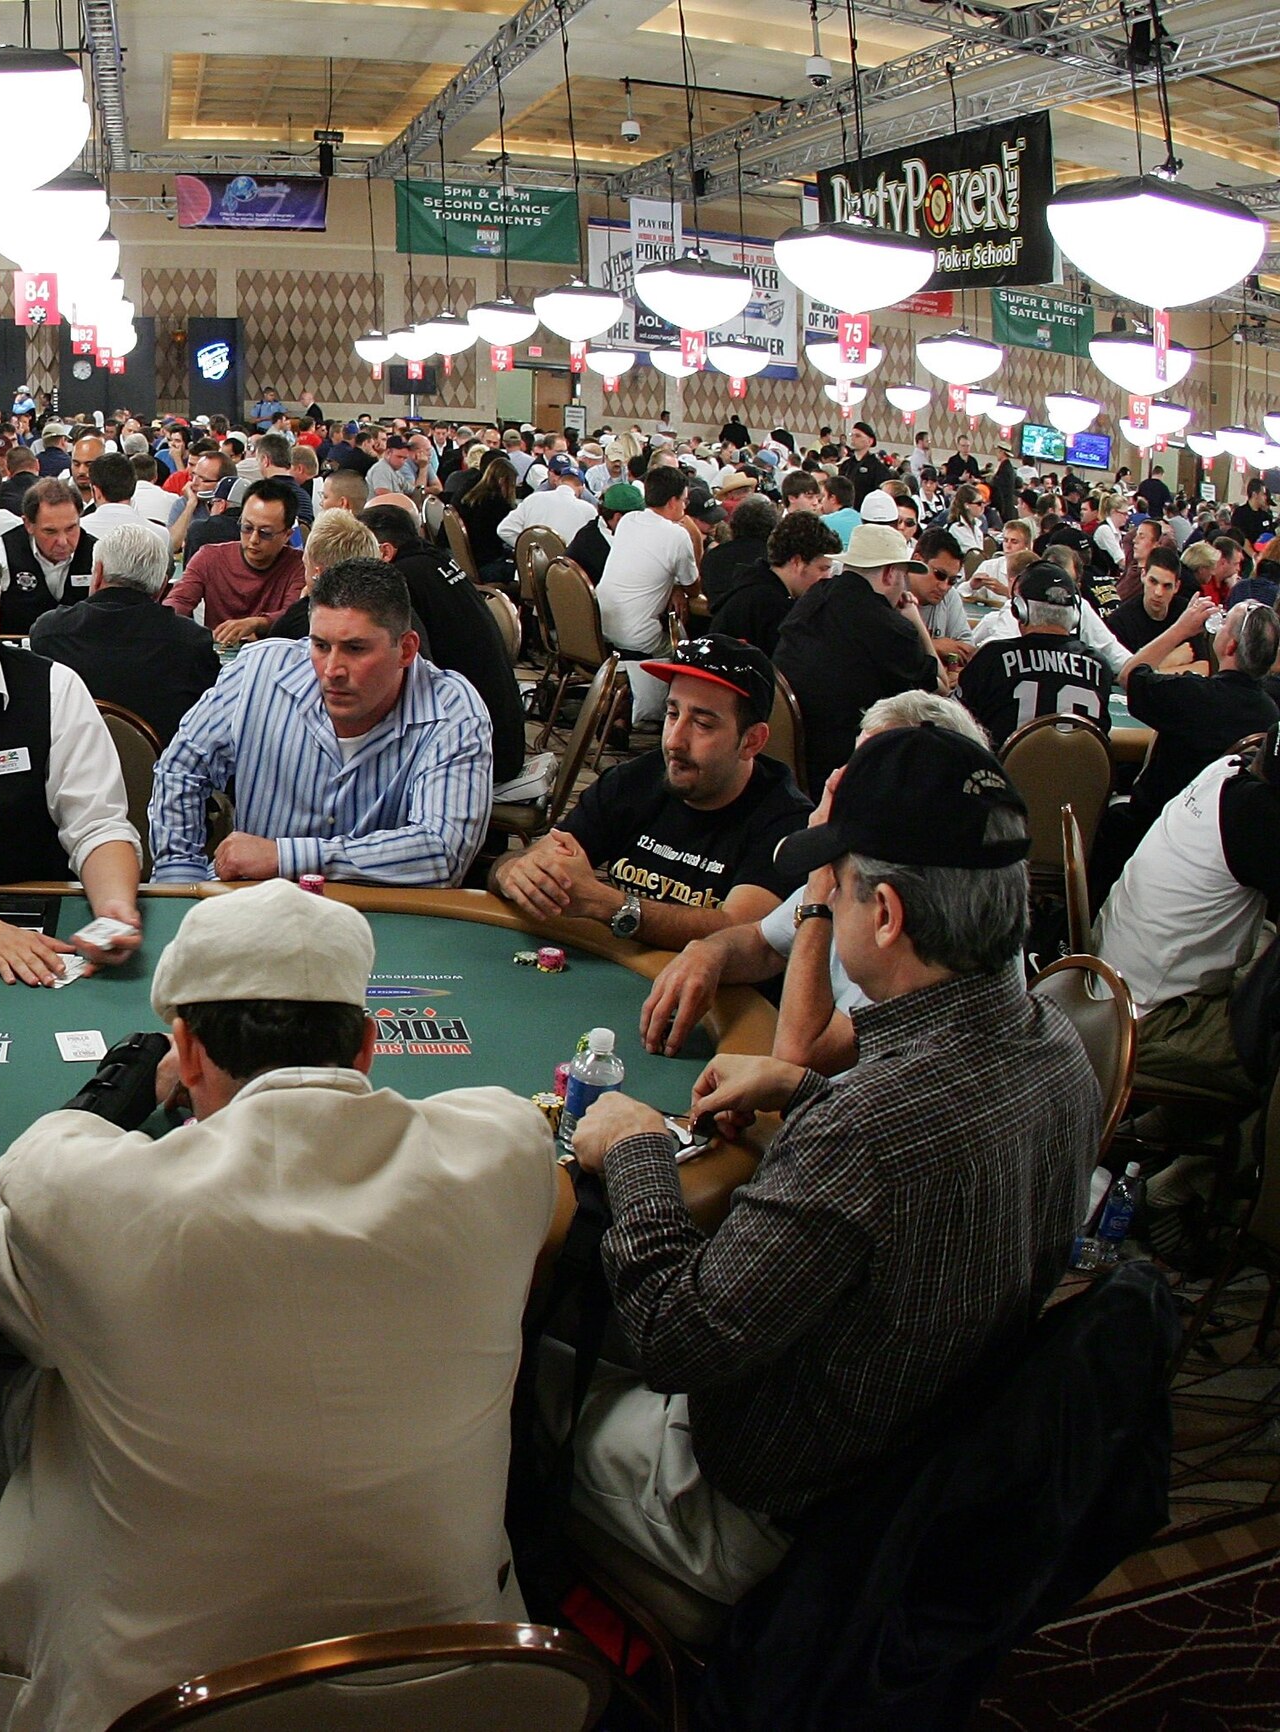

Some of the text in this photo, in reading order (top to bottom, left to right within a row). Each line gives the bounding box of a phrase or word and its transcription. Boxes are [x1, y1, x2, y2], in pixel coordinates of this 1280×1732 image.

[443, 185, 472, 198] 5PM
[478, 187, 490, 199] &
[423, 196, 551, 216] SECOND CHANCE
[432, 209, 543, 227] TOURNAMENTS
[638, 218, 656, 229] PLAY
[635, 242, 676, 262] POKER
[936, 239, 1019, 273] Poker School
[24, 280, 50, 302] 84
[810, 301, 830, 314] WORLD
[999, 290, 1086, 317] SUPER & MEGA
[638, 314, 662, 329] AOL
[808, 312, 820, 327] OF
[1009, 305, 1077, 327] SATELLITES
[79, 328, 94, 342] 82
[844, 322, 863, 344] 75
[1156, 321, 1167, 351] 76
[685, 337, 699, 353] 74
[495, 350, 508, 362] 72
[952, 388, 965, 401] 64
[1132, 401, 1147, 416] 65
[1001, 649, 1103, 687] PLUNKETT
[375, 1017, 472, 1043] POK
[373, 1042, 472, 1055] WORLD SER
